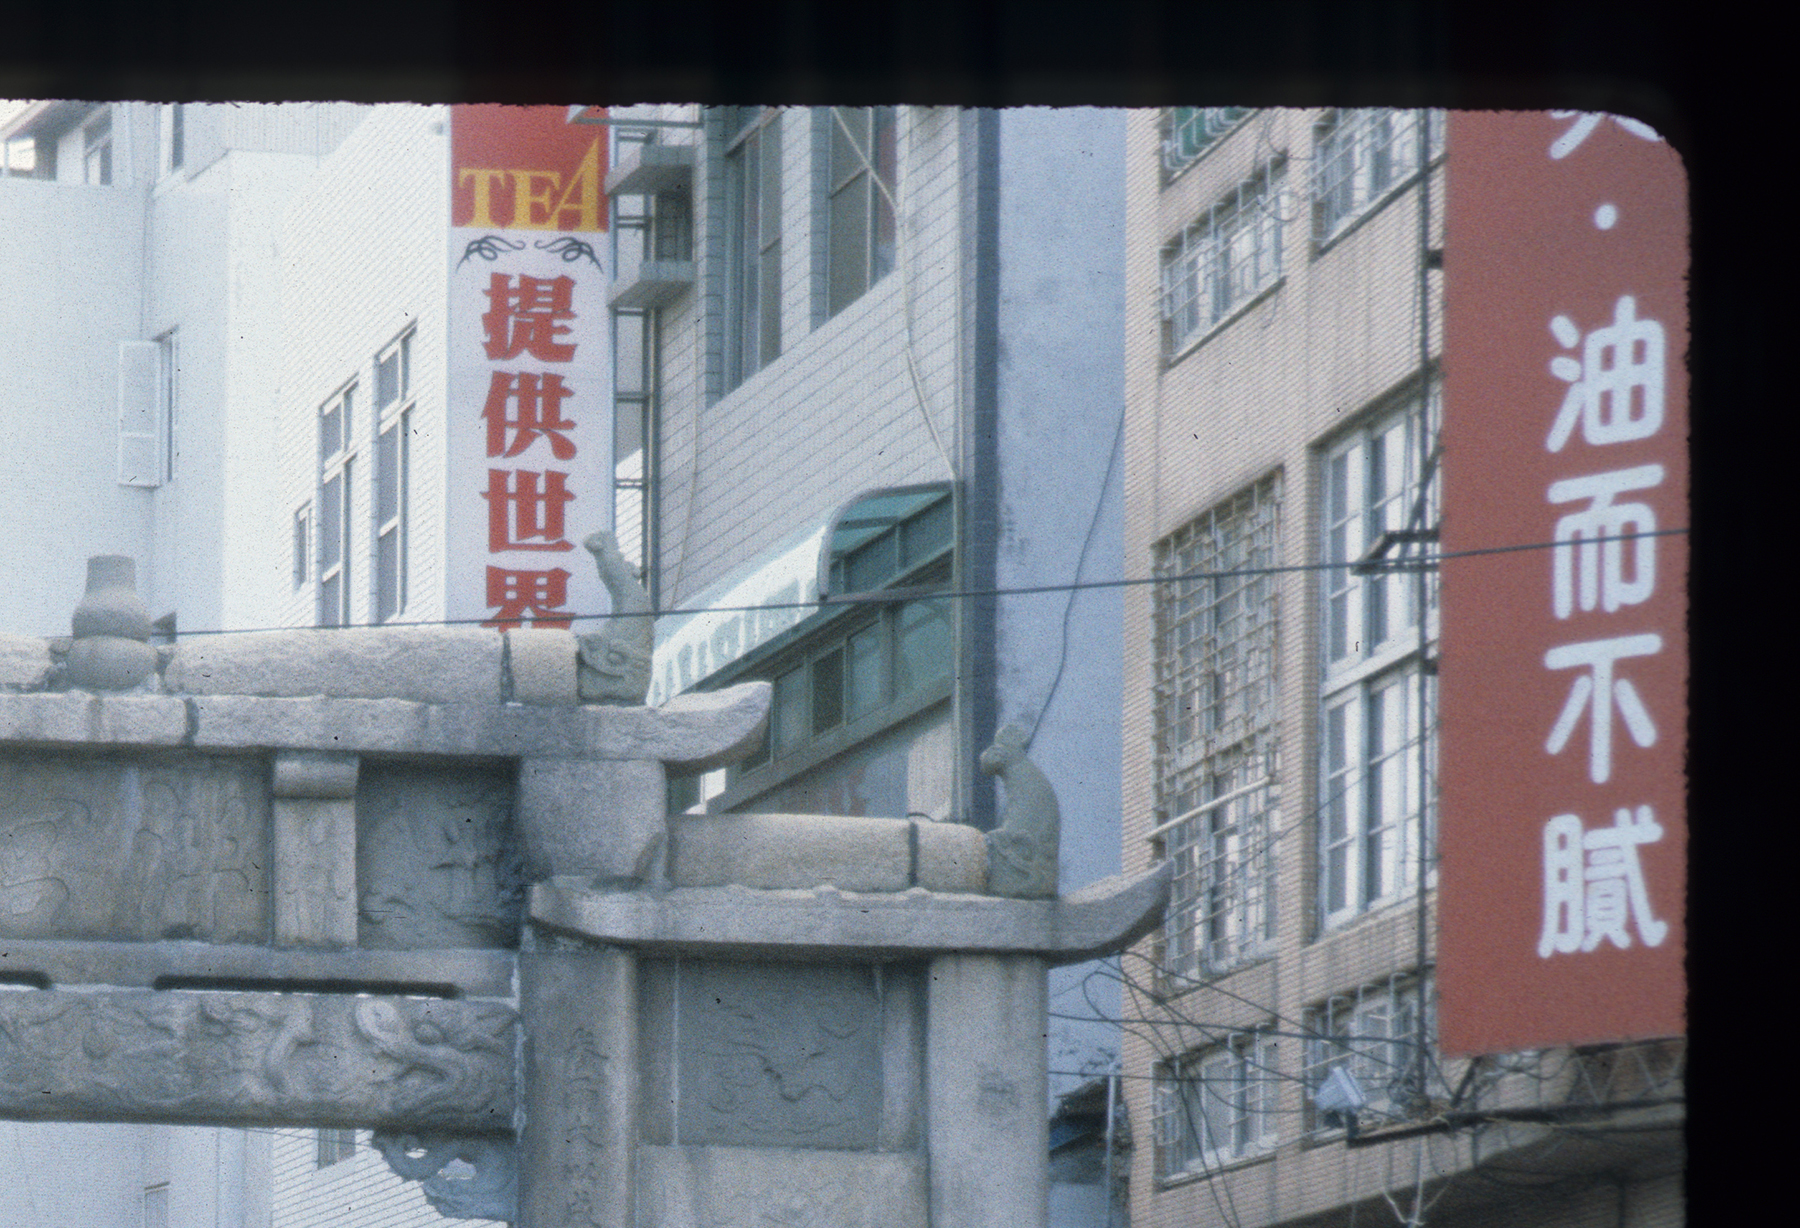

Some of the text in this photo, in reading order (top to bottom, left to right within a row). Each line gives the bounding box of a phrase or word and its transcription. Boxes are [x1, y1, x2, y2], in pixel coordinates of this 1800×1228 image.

[458, 137, 603, 233] TEA
[481, 271, 577, 631] 提供世界
